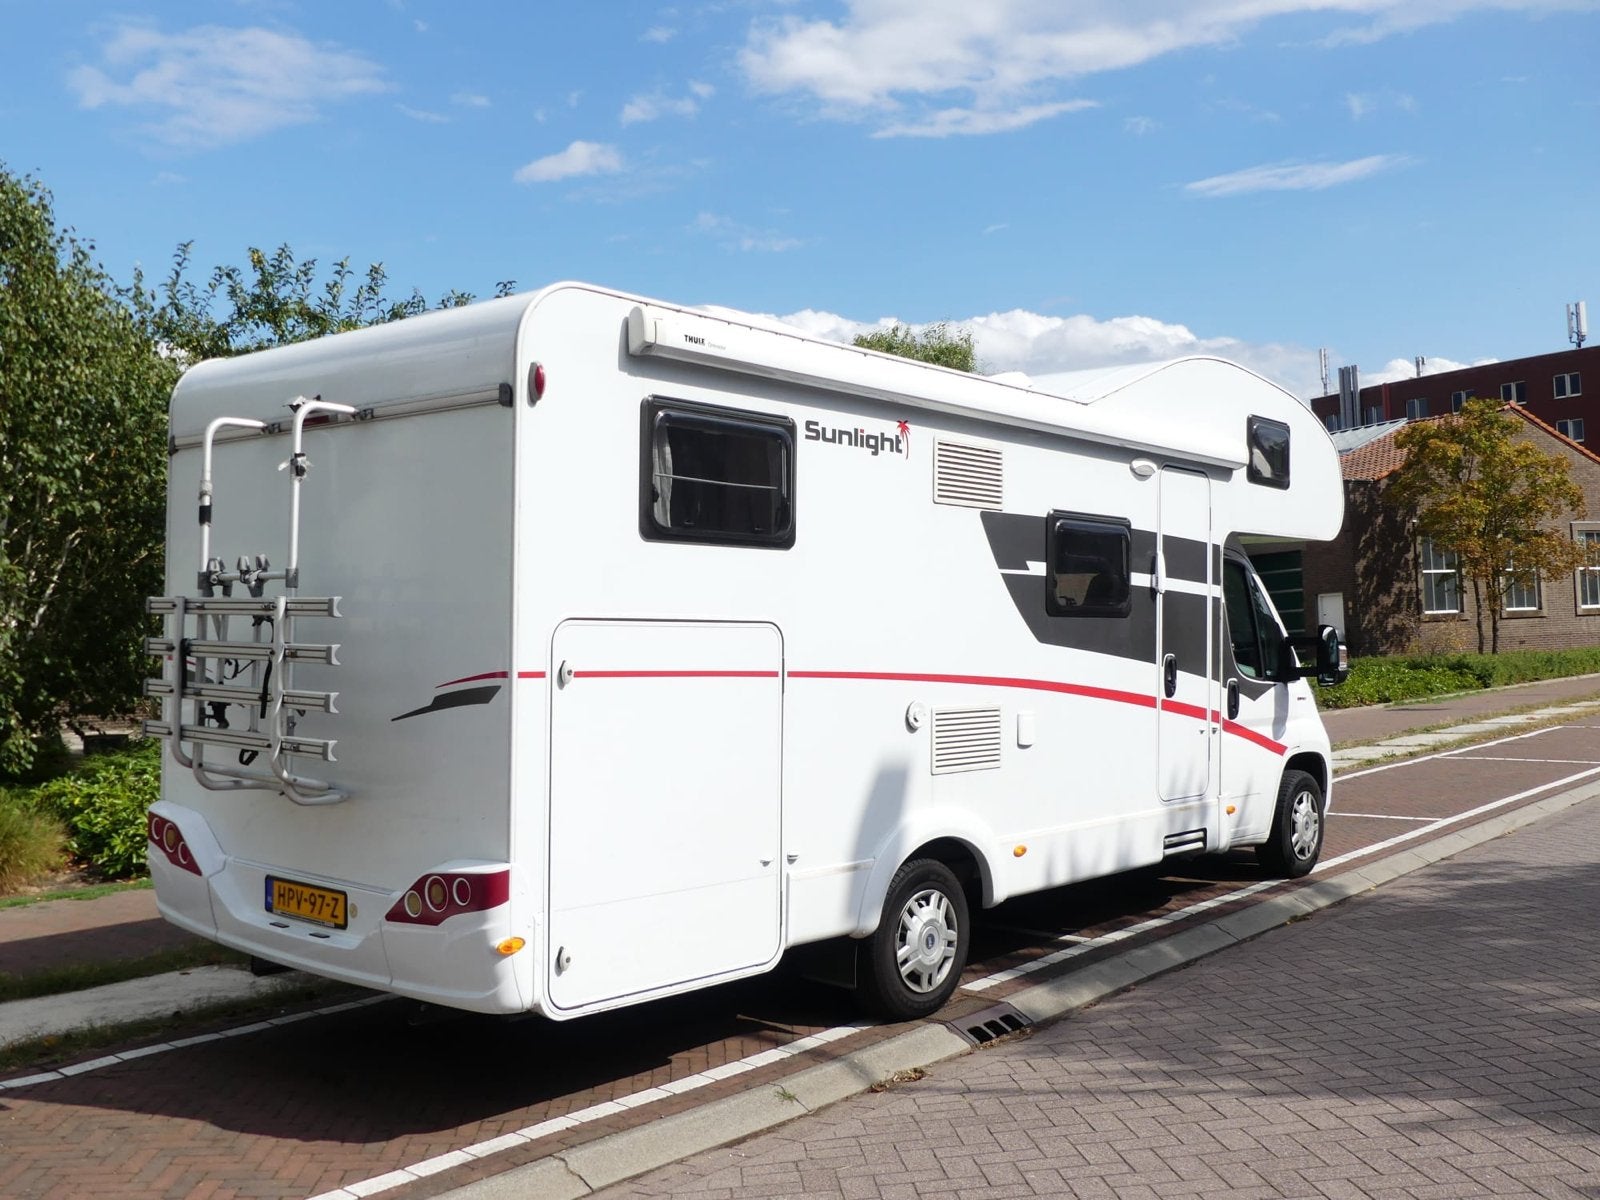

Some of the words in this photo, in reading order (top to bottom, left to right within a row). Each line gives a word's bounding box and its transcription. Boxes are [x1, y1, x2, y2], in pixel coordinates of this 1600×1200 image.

[684, 334, 706, 346] THULE
[805, 420, 903, 456] Sunlight
[277, 884, 340, 919] HPV-97-Z
